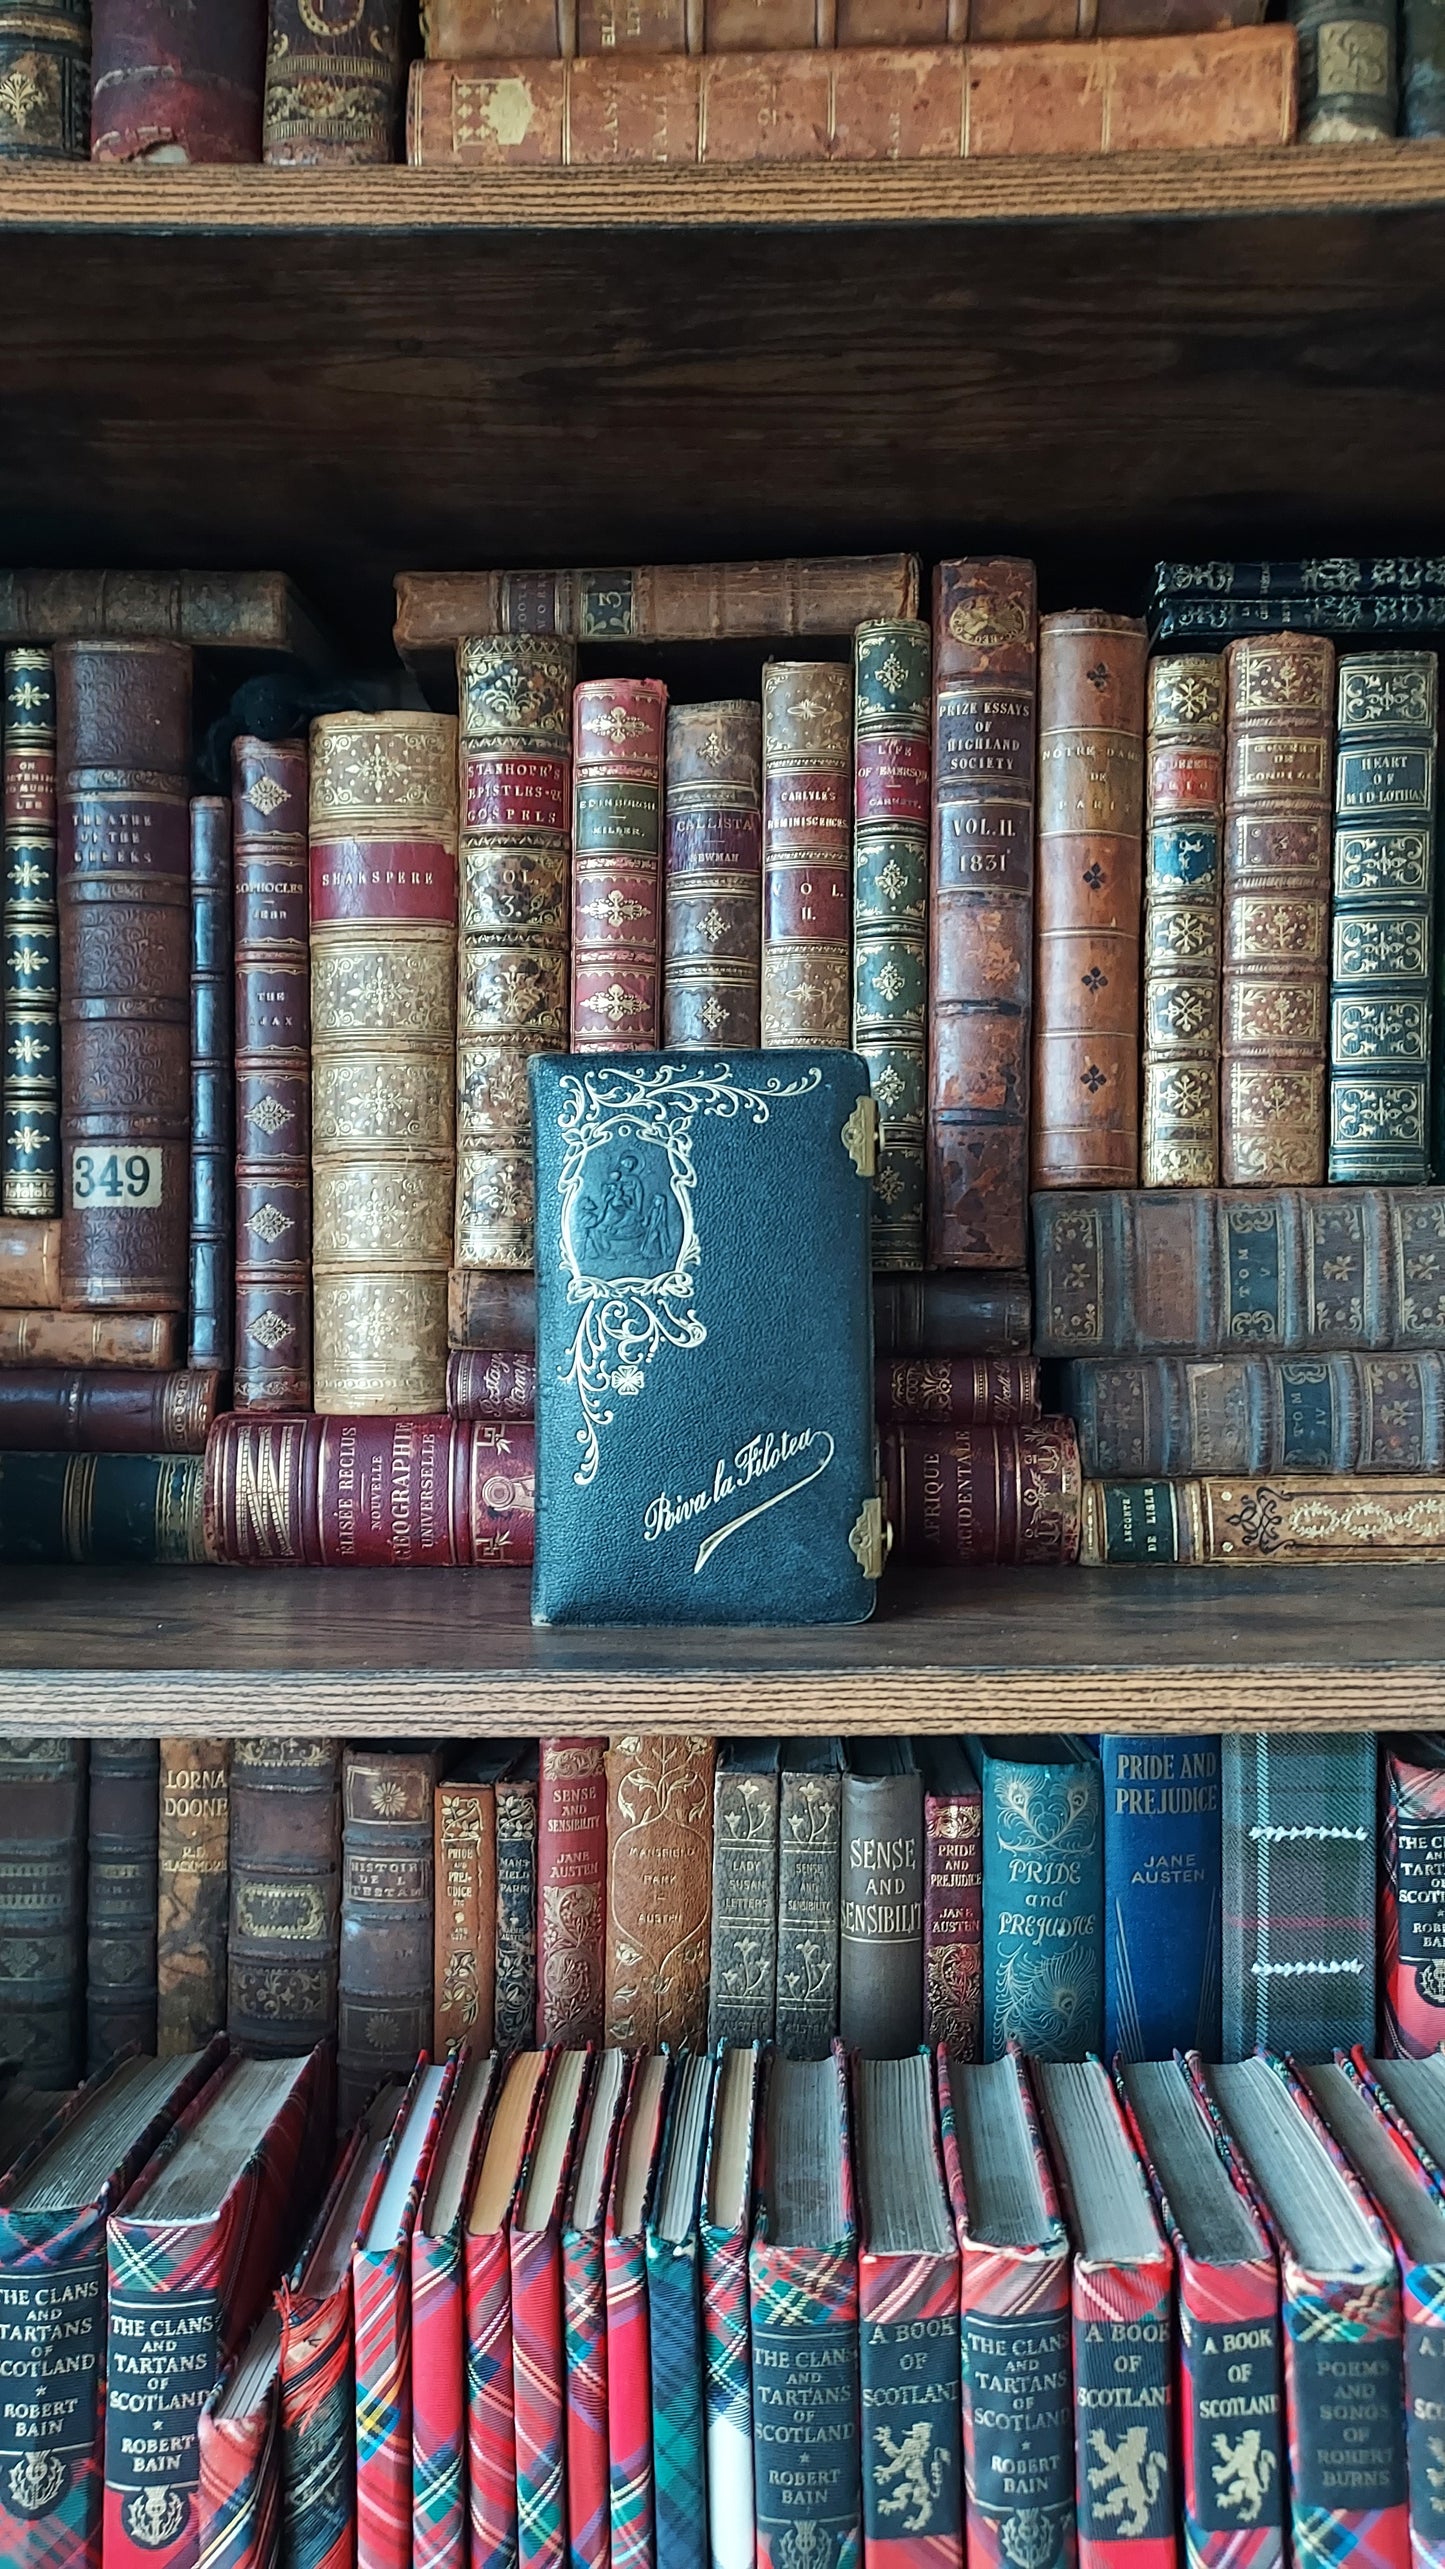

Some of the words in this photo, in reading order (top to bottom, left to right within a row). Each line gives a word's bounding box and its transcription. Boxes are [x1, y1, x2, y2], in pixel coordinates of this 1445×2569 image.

[598, 591, 622, 609] 3
[939, 702, 978, 717] PRIZE
[984, 702, 1030, 717] ESSAYS
[975, 721, 993, 733] OF
[878, 745, 911, 756] LIFE
[948, 739, 1020, 752] HIGHLAND
[19, 761, 36, 770] ON
[467, 763, 561, 779] STANHOPE'S
[858, 767, 873, 777] OF
[950, 757, 1014, 770] SOCIETY
[1361, 755, 1408, 771] HEART
[1090, 772, 1107, 782] DE
[1373, 773, 1396, 786] OF
[781, 787, 836, 802] CARLYLE'S
[72, 813, 152, 827] THEATRE
[467, 808, 557, 823] GOSPELS
[676, 817, 753, 832] CALLISTA
[953, 818, 996, 837] VOL.
[108, 831, 141, 845] THE
[959, 853, 1006, 873] 1831
[322, 871, 434, 886] SHAKSPERE
[235, 882, 304, 895] SOPHOCLES
[257, 991, 285, 1002] THE
[74, 1155, 151, 1198] 349
[479, 1352, 510, 1418] Postage
[338, 1426, 357, 1491] RECLUS
[712, 1458, 737, 1504] la
[734, 1427, 813, 1487] Filotea
[370, 1454, 384, 1531] NOUVELLE
[419, 1433, 436, 1549] UNIVERSELLE
[923, 1452, 944, 1543] AFRIQUE
[1146, 1534, 1158, 1552] DE
[1117, 1753, 1173, 1781] PRIDE
[1178, 1751, 1217, 1780] AND
[165, 1769, 228, 1790] LORNA
[553, 1786, 597, 1803] SENSE
[1115, 1785, 1218, 1816] PREJUDICE
[164, 1796, 229, 1817] DOONE
[561, 1804, 587, 1817] AND
[547, 1814, 600, 1834] SENSIBILITY
[938, 1843, 976, 1857] PRIDE
[1398, 1835, 1428, 1850] THE
[447, 1848, 473, 1860] PRIDE
[556, 1850, 590, 1865] JANE
[850, 1837, 917, 1872] SENSE
[1143, 1853, 1197, 1869] JANE
[549, 1862, 599, 1879] AUSTEN
[732, 1860, 761, 1873] LADY
[795, 1863, 823, 1875] SENSE
[945, 1859, 970, 1872] AND
[1007, 1858, 1082, 1886] PRIDE
[358, 1874, 380, 1884] DE
[728, 1879, 765, 1891] SUSAN
[930, 1872, 982, 1887] PREJUDICE
[1131, 1868, 1205, 1884] AUSTEN
[800, 1881, 820, 1892] AND
[864, 1878, 906, 1896] AND
[725, 1898, 768, 1910] LETTERS
[1025, 1890, 1068, 1908] and
[840, 1899, 922, 1936] SENSIBILIT
[939, 1906, 973, 1919] JANE
[932, 1919, 980, 1934] AUSTEN
[998, 1910, 1097, 1946] PREJUDICE
[33, 2280, 99, 2305] CLANS
[26, 2307, 63, 2322] AND
[0, 2316, 93, 2343] TARTANS
[110, 2314, 146, 2337] THE
[149, 2314, 214, 2337] CLANS
[868, 2324, 889, 2345] A
[1084, 2324, 1104, 2343] A
[141, 2339, 178, 2353] AND
[967, 2331, 1008, 2357] THE
[1012, 2331, 1069, 2356] CLANS
[1202, 2336, 1218, 2356] A
[1222, 2328, 1275, 2353] BOOK
[1418, 2335, 1436, 2358] A
[30, 2345, 54, 2358] OF
[753, 2347, 790, 2368] THE
[0, 2353, 96, 2378] COTLAND
[113, 2352, 208, 2375] TARTANS
[899, 2351, 929, 2371] OF
[1004, 2359, 1040, 2372] AND
[1112, 2355, 1142, 2373] OF
[1317, 2359, 1391, 2378] POEMS
[785, 2371, 822, 2385] AND
[1227, 2362, 1253, 2384] OF
[146, 2376, 170, 2391] OF
[974, 2370, 1068, 2395] TARTANS
[1333, 2382, 1377, 2399] AND
[756, 2384, 852, 2406] TARTANS
[1012, 2396, 1036, 2411] OF
[3, 2397, 79, 2419] ROBERT
[793, 2409, 817, 2424] OF
[1319, 2403, 1390, 2421] SONGS
[14, 2418, 65, 2438] BAIN
[974, 2406, 1071, 2432] SCOTLAND
[754, 2422, 856, 2444] SCOTLAND
[1342, 2426, 1371, 2443] OF
[120, 2433, 196, 2455] ROBERT
[131, 2454, 182, 2473] BAIN
[990, 2454, 1061, 2476] ROBERT
[768, 2468, 842, 2487] ROBERT
[1003, 2476, 1049, 2494] BAIN
[1322, 2470, 1391, 2488] BURNS
[781, 2488, 829, 2505] BAIN
